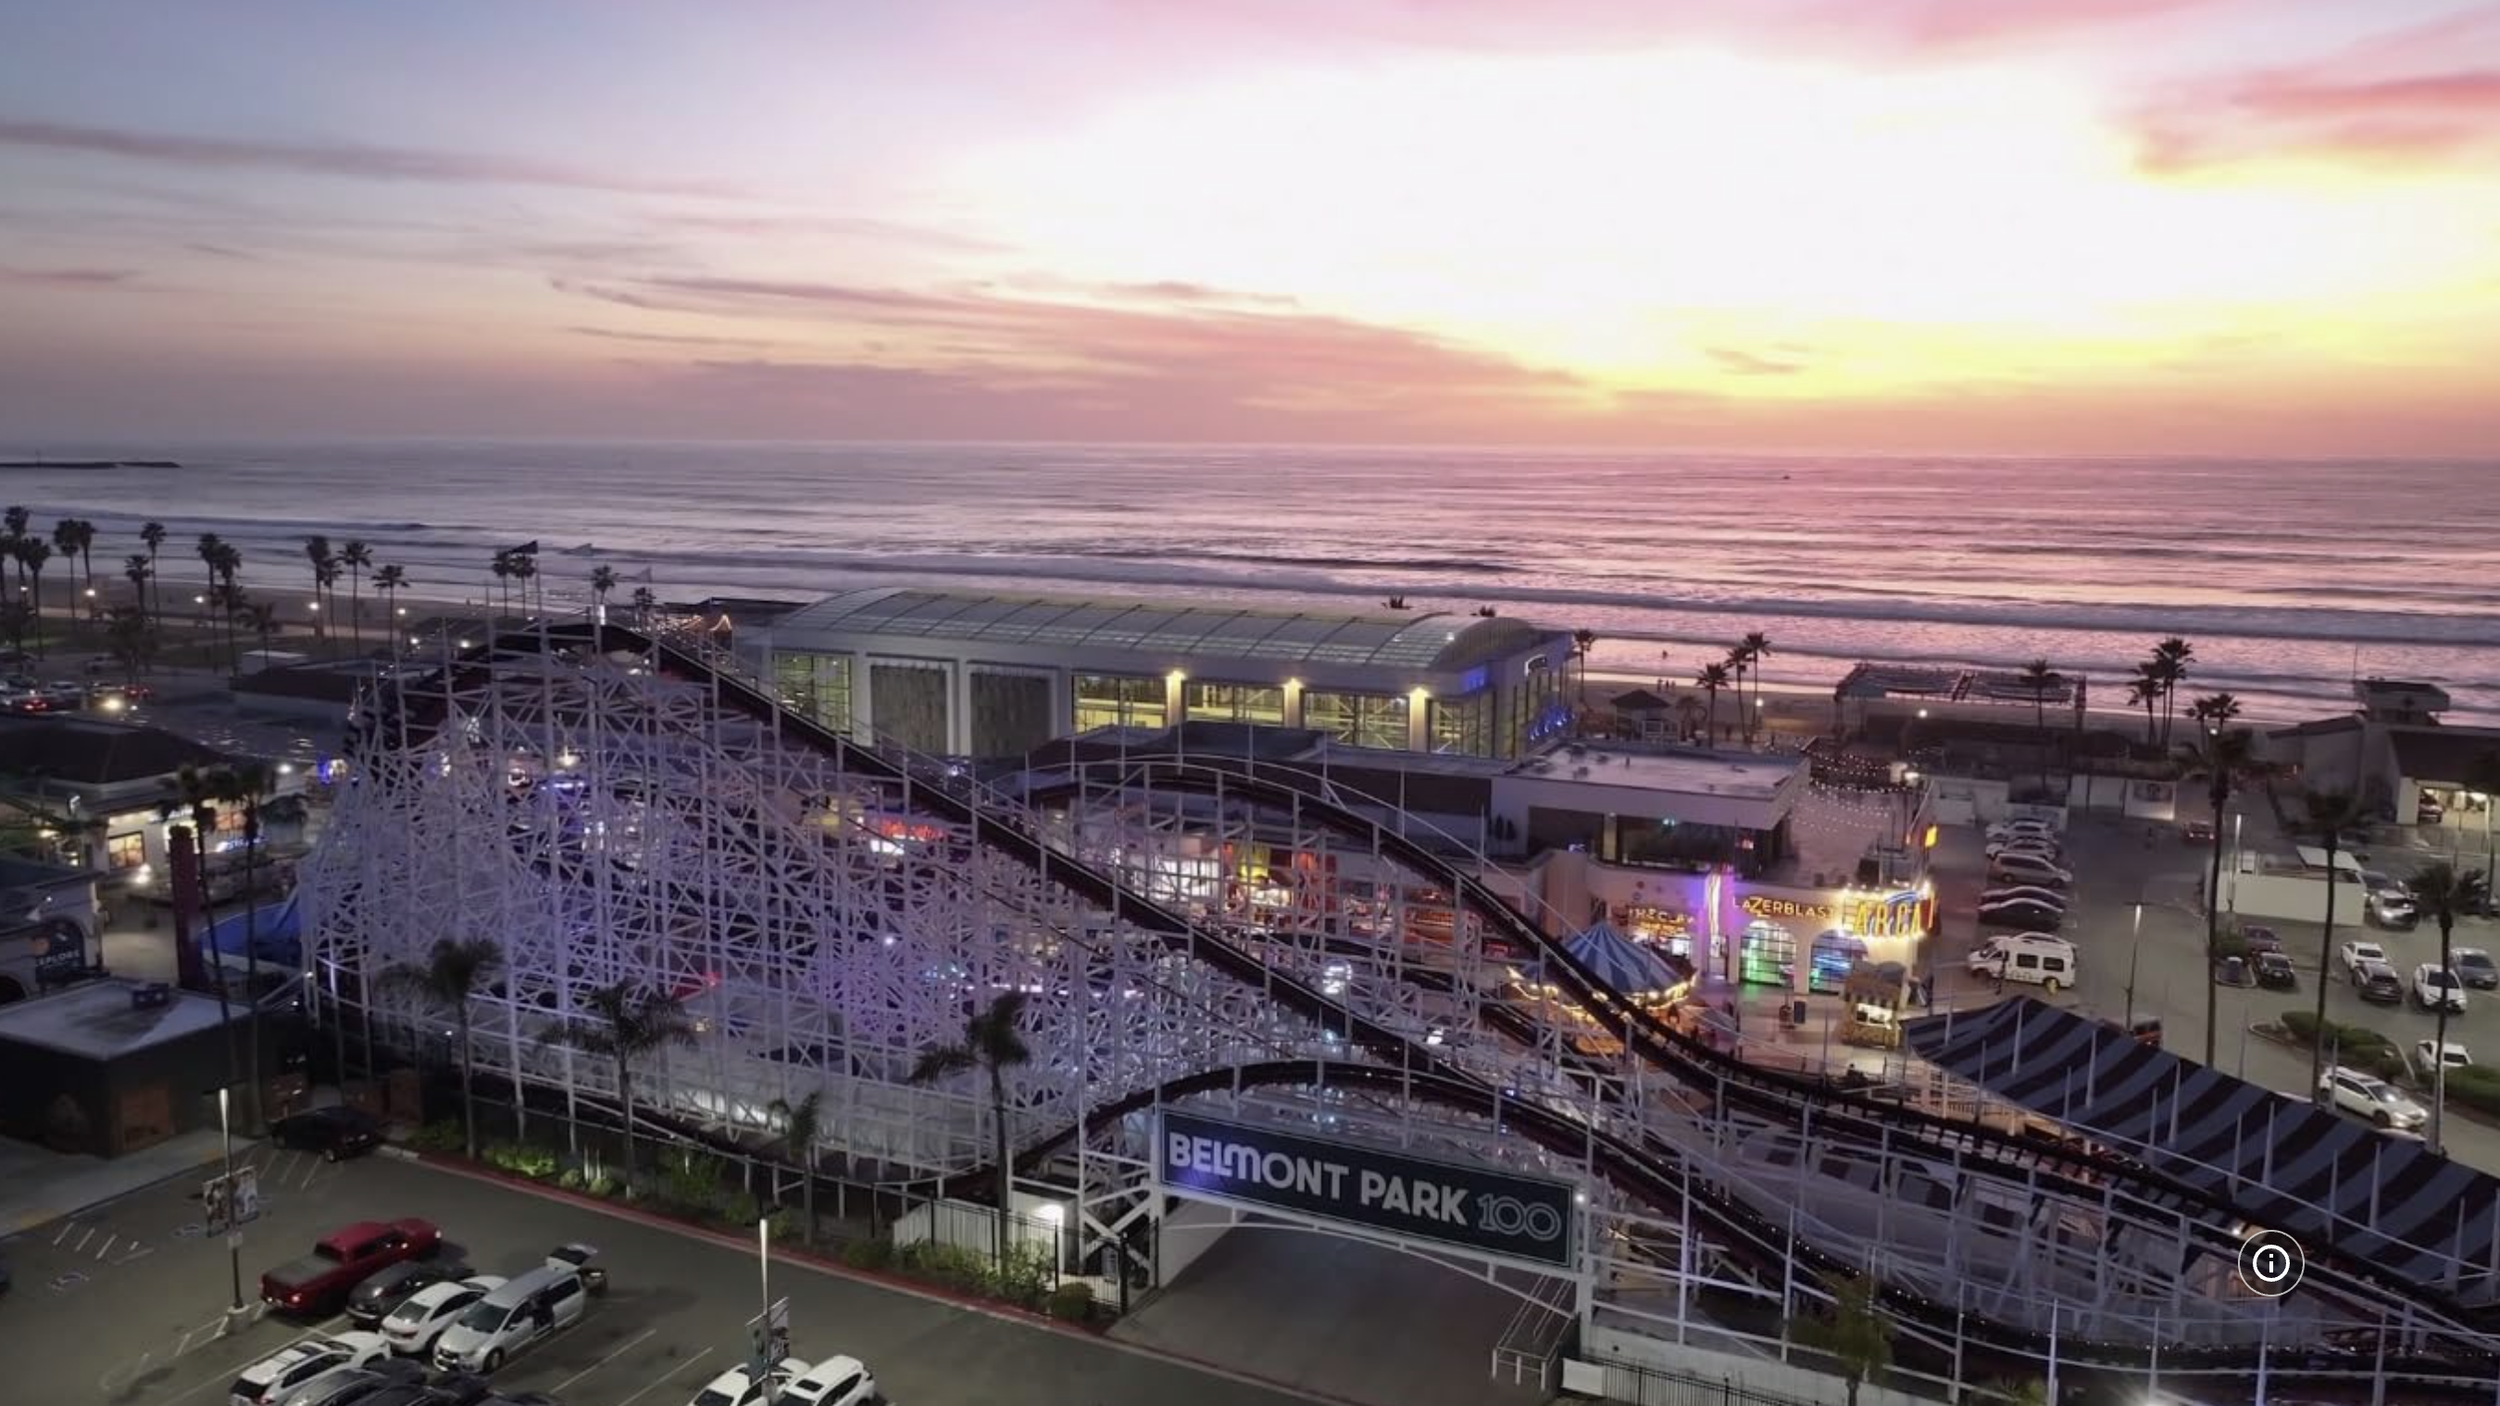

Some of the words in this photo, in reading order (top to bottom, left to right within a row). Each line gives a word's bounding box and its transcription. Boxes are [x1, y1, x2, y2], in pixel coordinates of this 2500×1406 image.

[1169, 1133, 1349, 1200] BELMONT
[1360, 1169, 1469, 1226] PARK
[1476, 1192, 1562, 1242] 100
